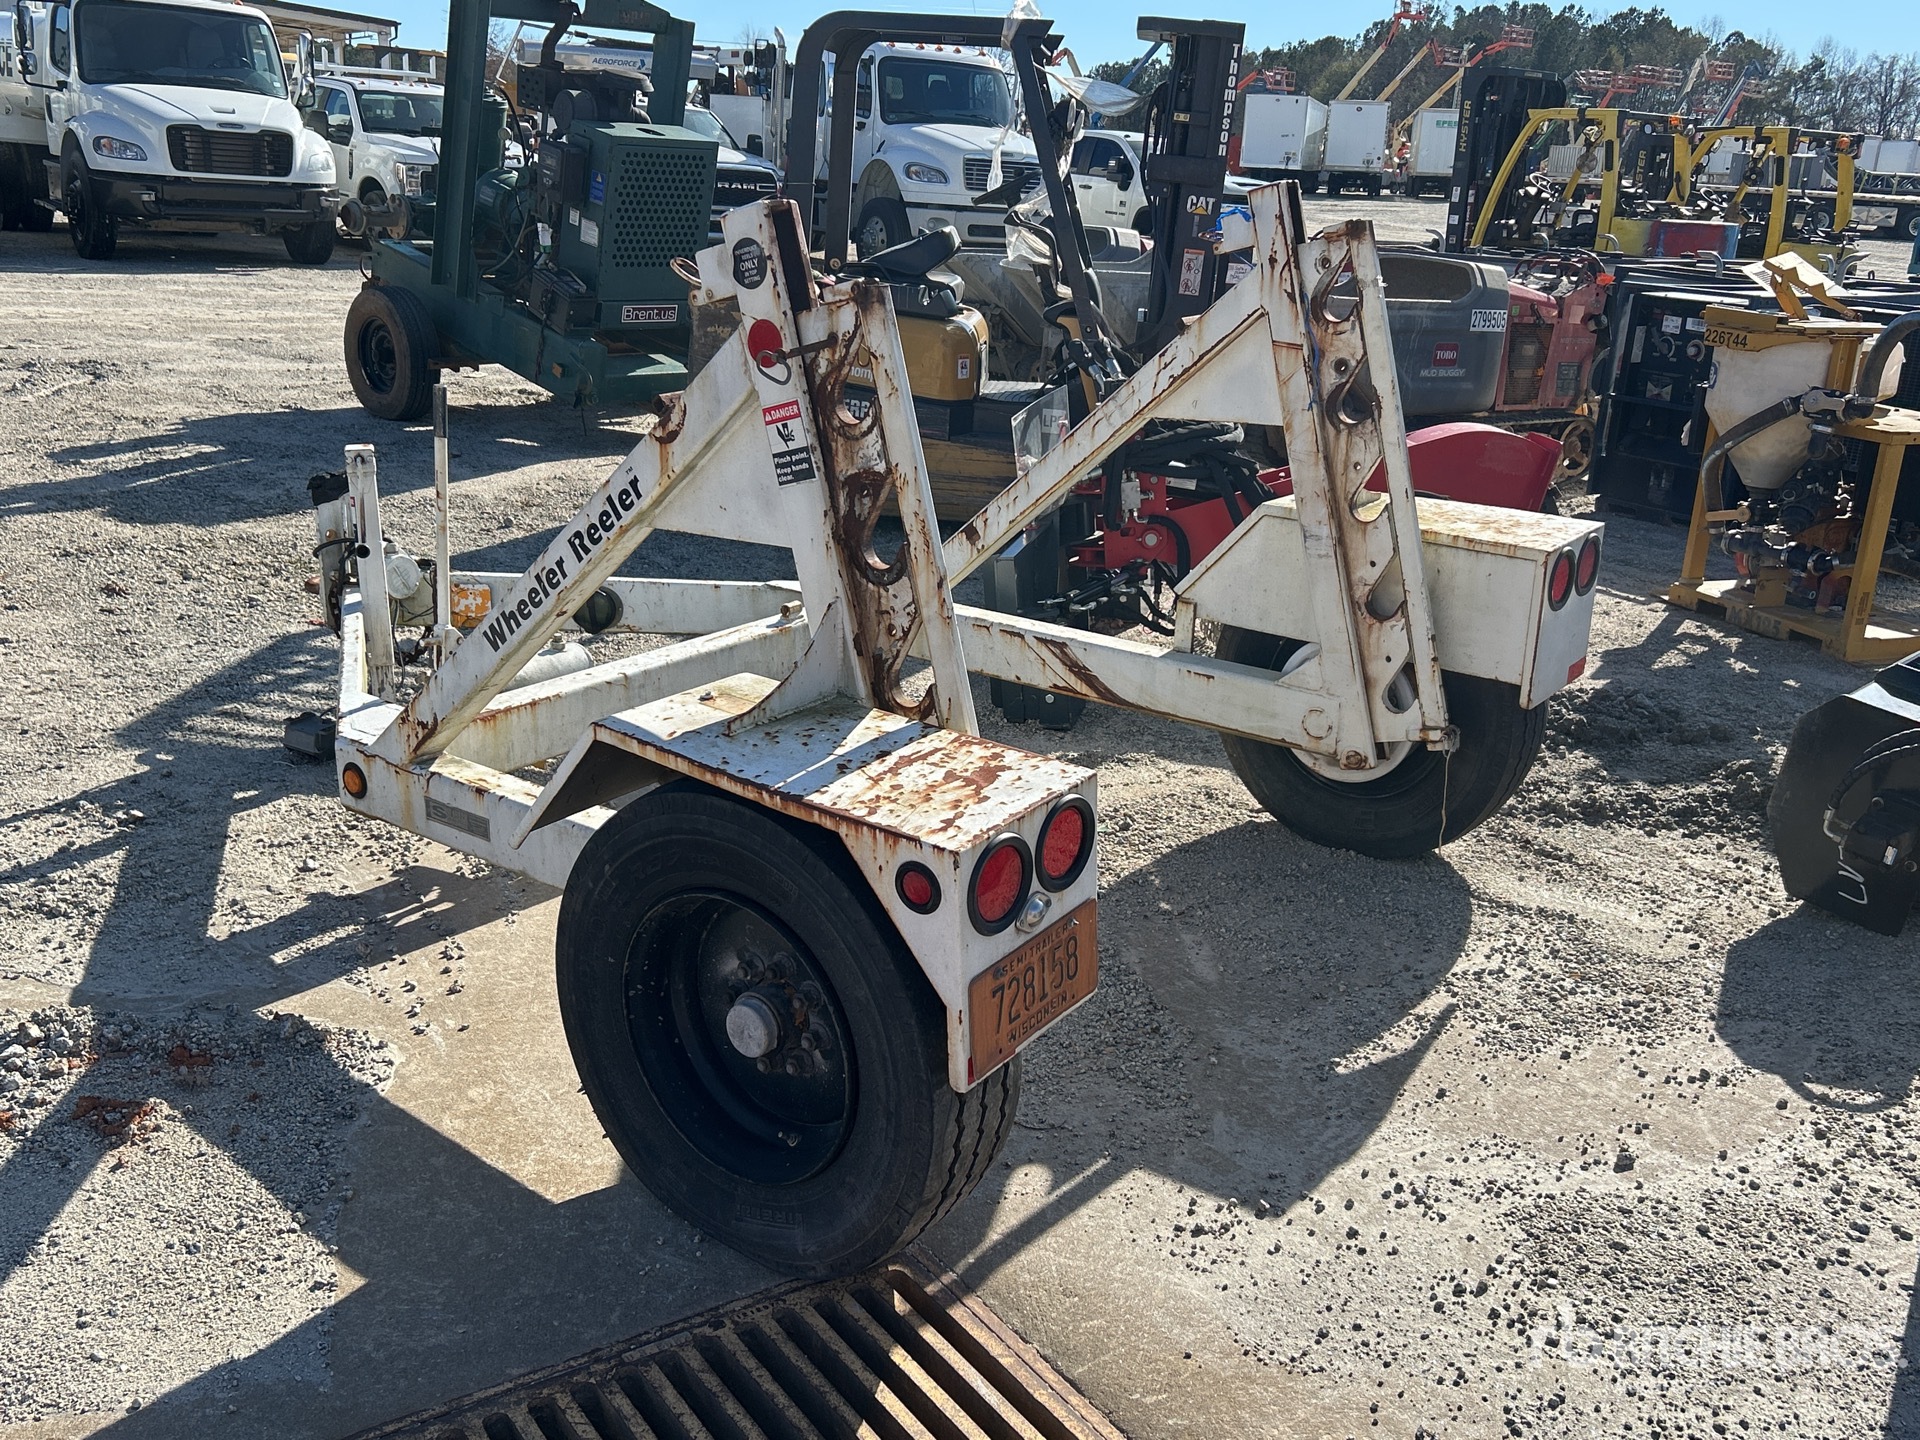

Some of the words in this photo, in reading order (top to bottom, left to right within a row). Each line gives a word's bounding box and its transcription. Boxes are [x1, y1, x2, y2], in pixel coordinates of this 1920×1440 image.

[592, 57, 638, 67] AEROFORCE
[1218, 43, 1241, 157] Thompson
[1459, 100, 1472, 152] HYSTER
[717, 181, 756, 190] RAM
[1186, 195, 1216, 215] CAT
[740, 257, 759, 271] ONLY
[743, 275, 761, 284] SETTING
[623, 307, 675, 320] Brent.us
[1471, 310, 1507, 329] 2799505
[1704, 328, 1749, 348] 226744
[1435, 350, 1457, 360] TORO
[1420, 369, 1438, 377] MUD
[1439, 369, 1465, 377] BUGGY
[771, 405, 799, 420] DANGER
[774, 455, 791, 464] Pinch
[791, 451, 809, 462] point.
[776, 466, 791, 474] Keep
[791, 462, 809, 471] hands
[778, 474, 794, 482] clear.
[482, 556, 568, 652] Wheeler
[567, 475, 643, 563] Reeler
[1003, 951, 1027, 974] SEMI
[1029, 922, 1068, 957] TRAILER
[992, 935, 1078, 1035] 728158
[1007, 991, 1067, 1043] WISCONSIN
